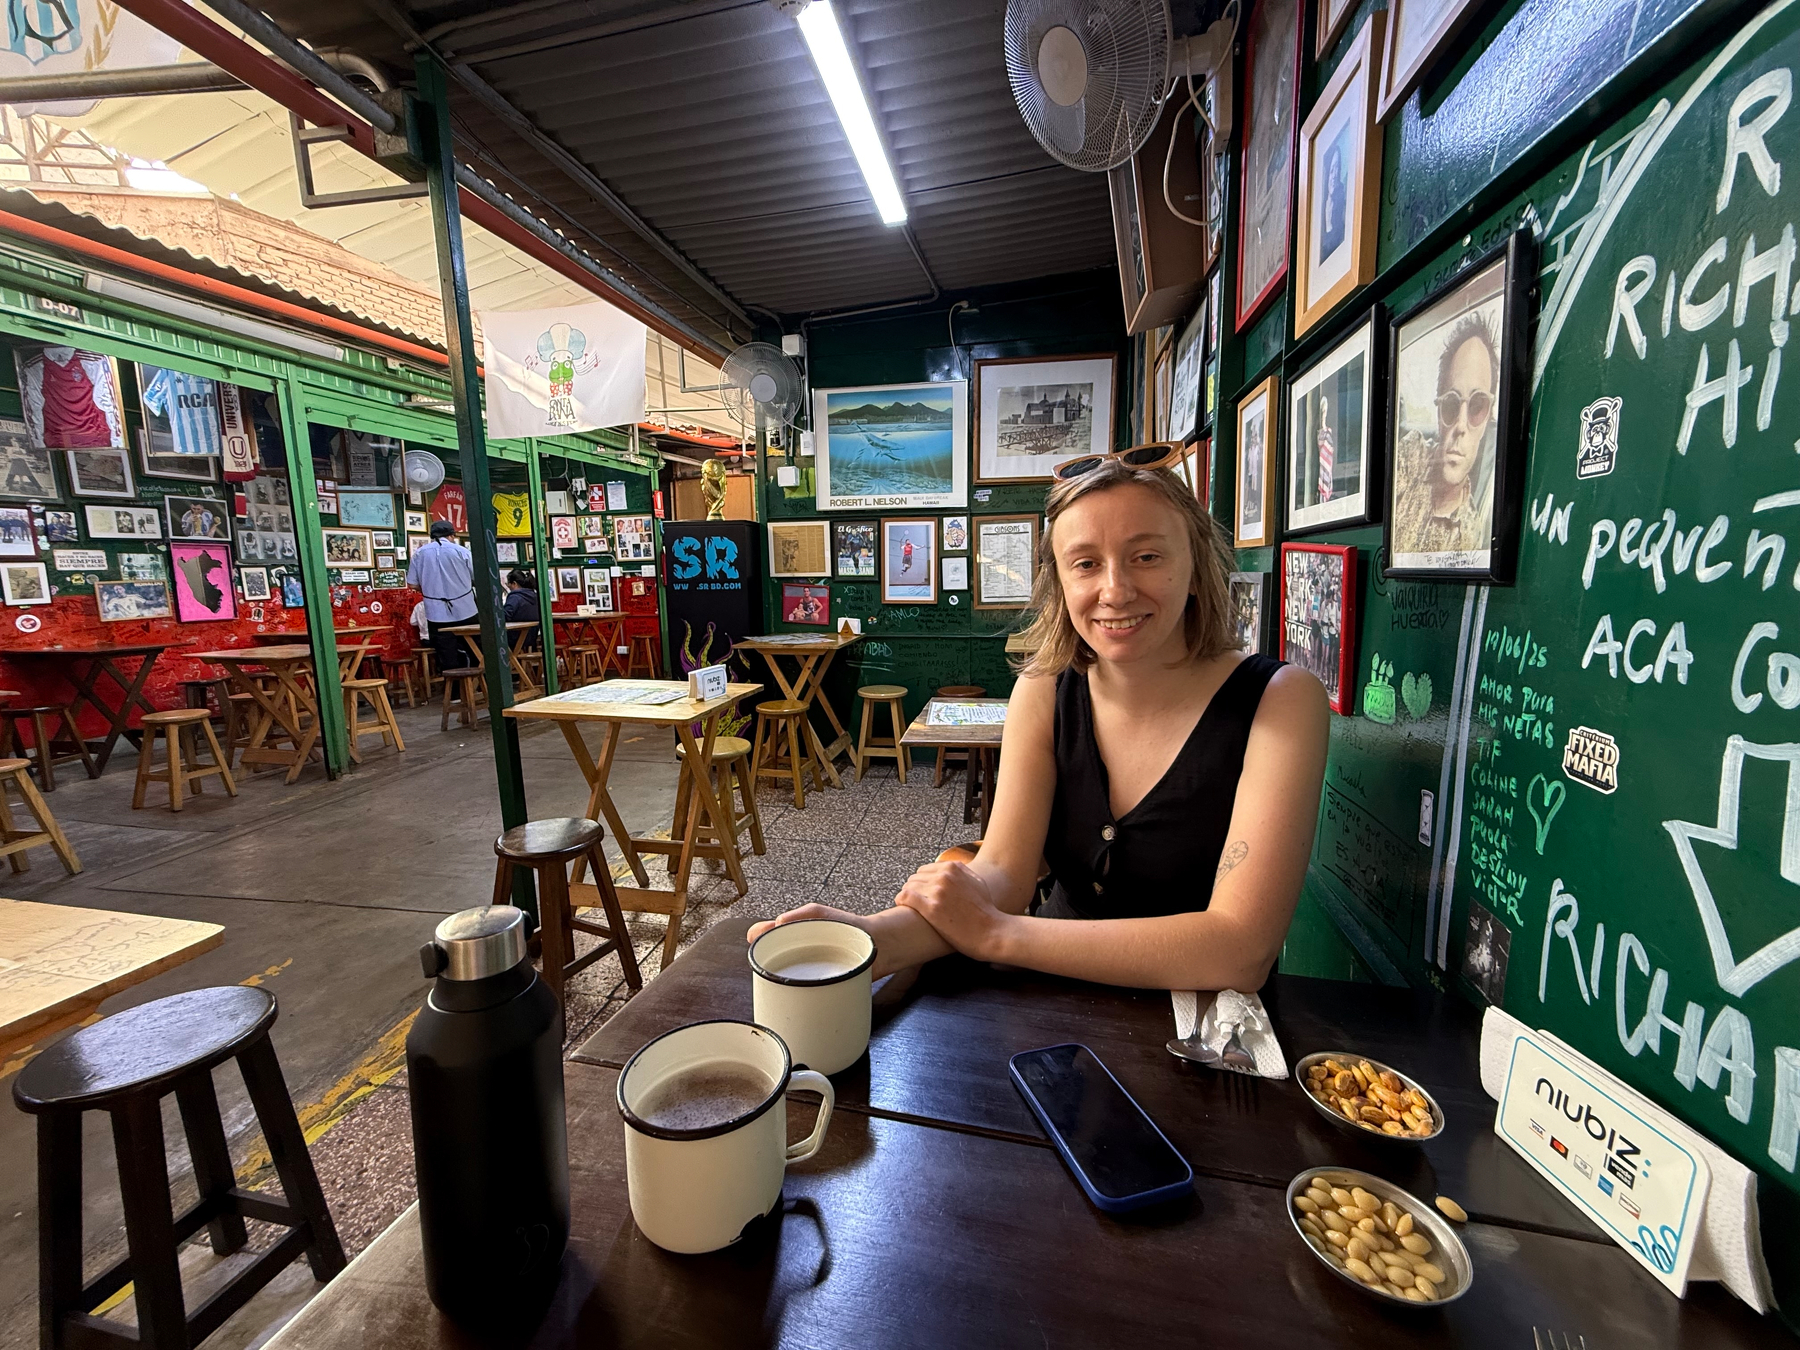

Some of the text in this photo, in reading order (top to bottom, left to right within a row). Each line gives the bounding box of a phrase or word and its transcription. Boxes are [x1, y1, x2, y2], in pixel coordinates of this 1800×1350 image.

[1604, 222, 1800, 360] RICH
[41, 297, 79, 317] D-07
[177, 393, 215, 408] RCA
[1581, 461, 1610, 475] MONKEY
[830, 497, 907, 507] ROBERT L. NELSON
[512, 507, 524, 527] 9
[672, 536, 739, 579] SR
[1285, 552, 1308, 573] NEW
[1285, 599, 1307, 624] NEW
[1285, 621, 1312, 651] YORK
[1581, 614, 1694, 685] ACA
[1570, 733, 1617, 765] FIXED
[1565, 749, 1614, 786] MAFIA
